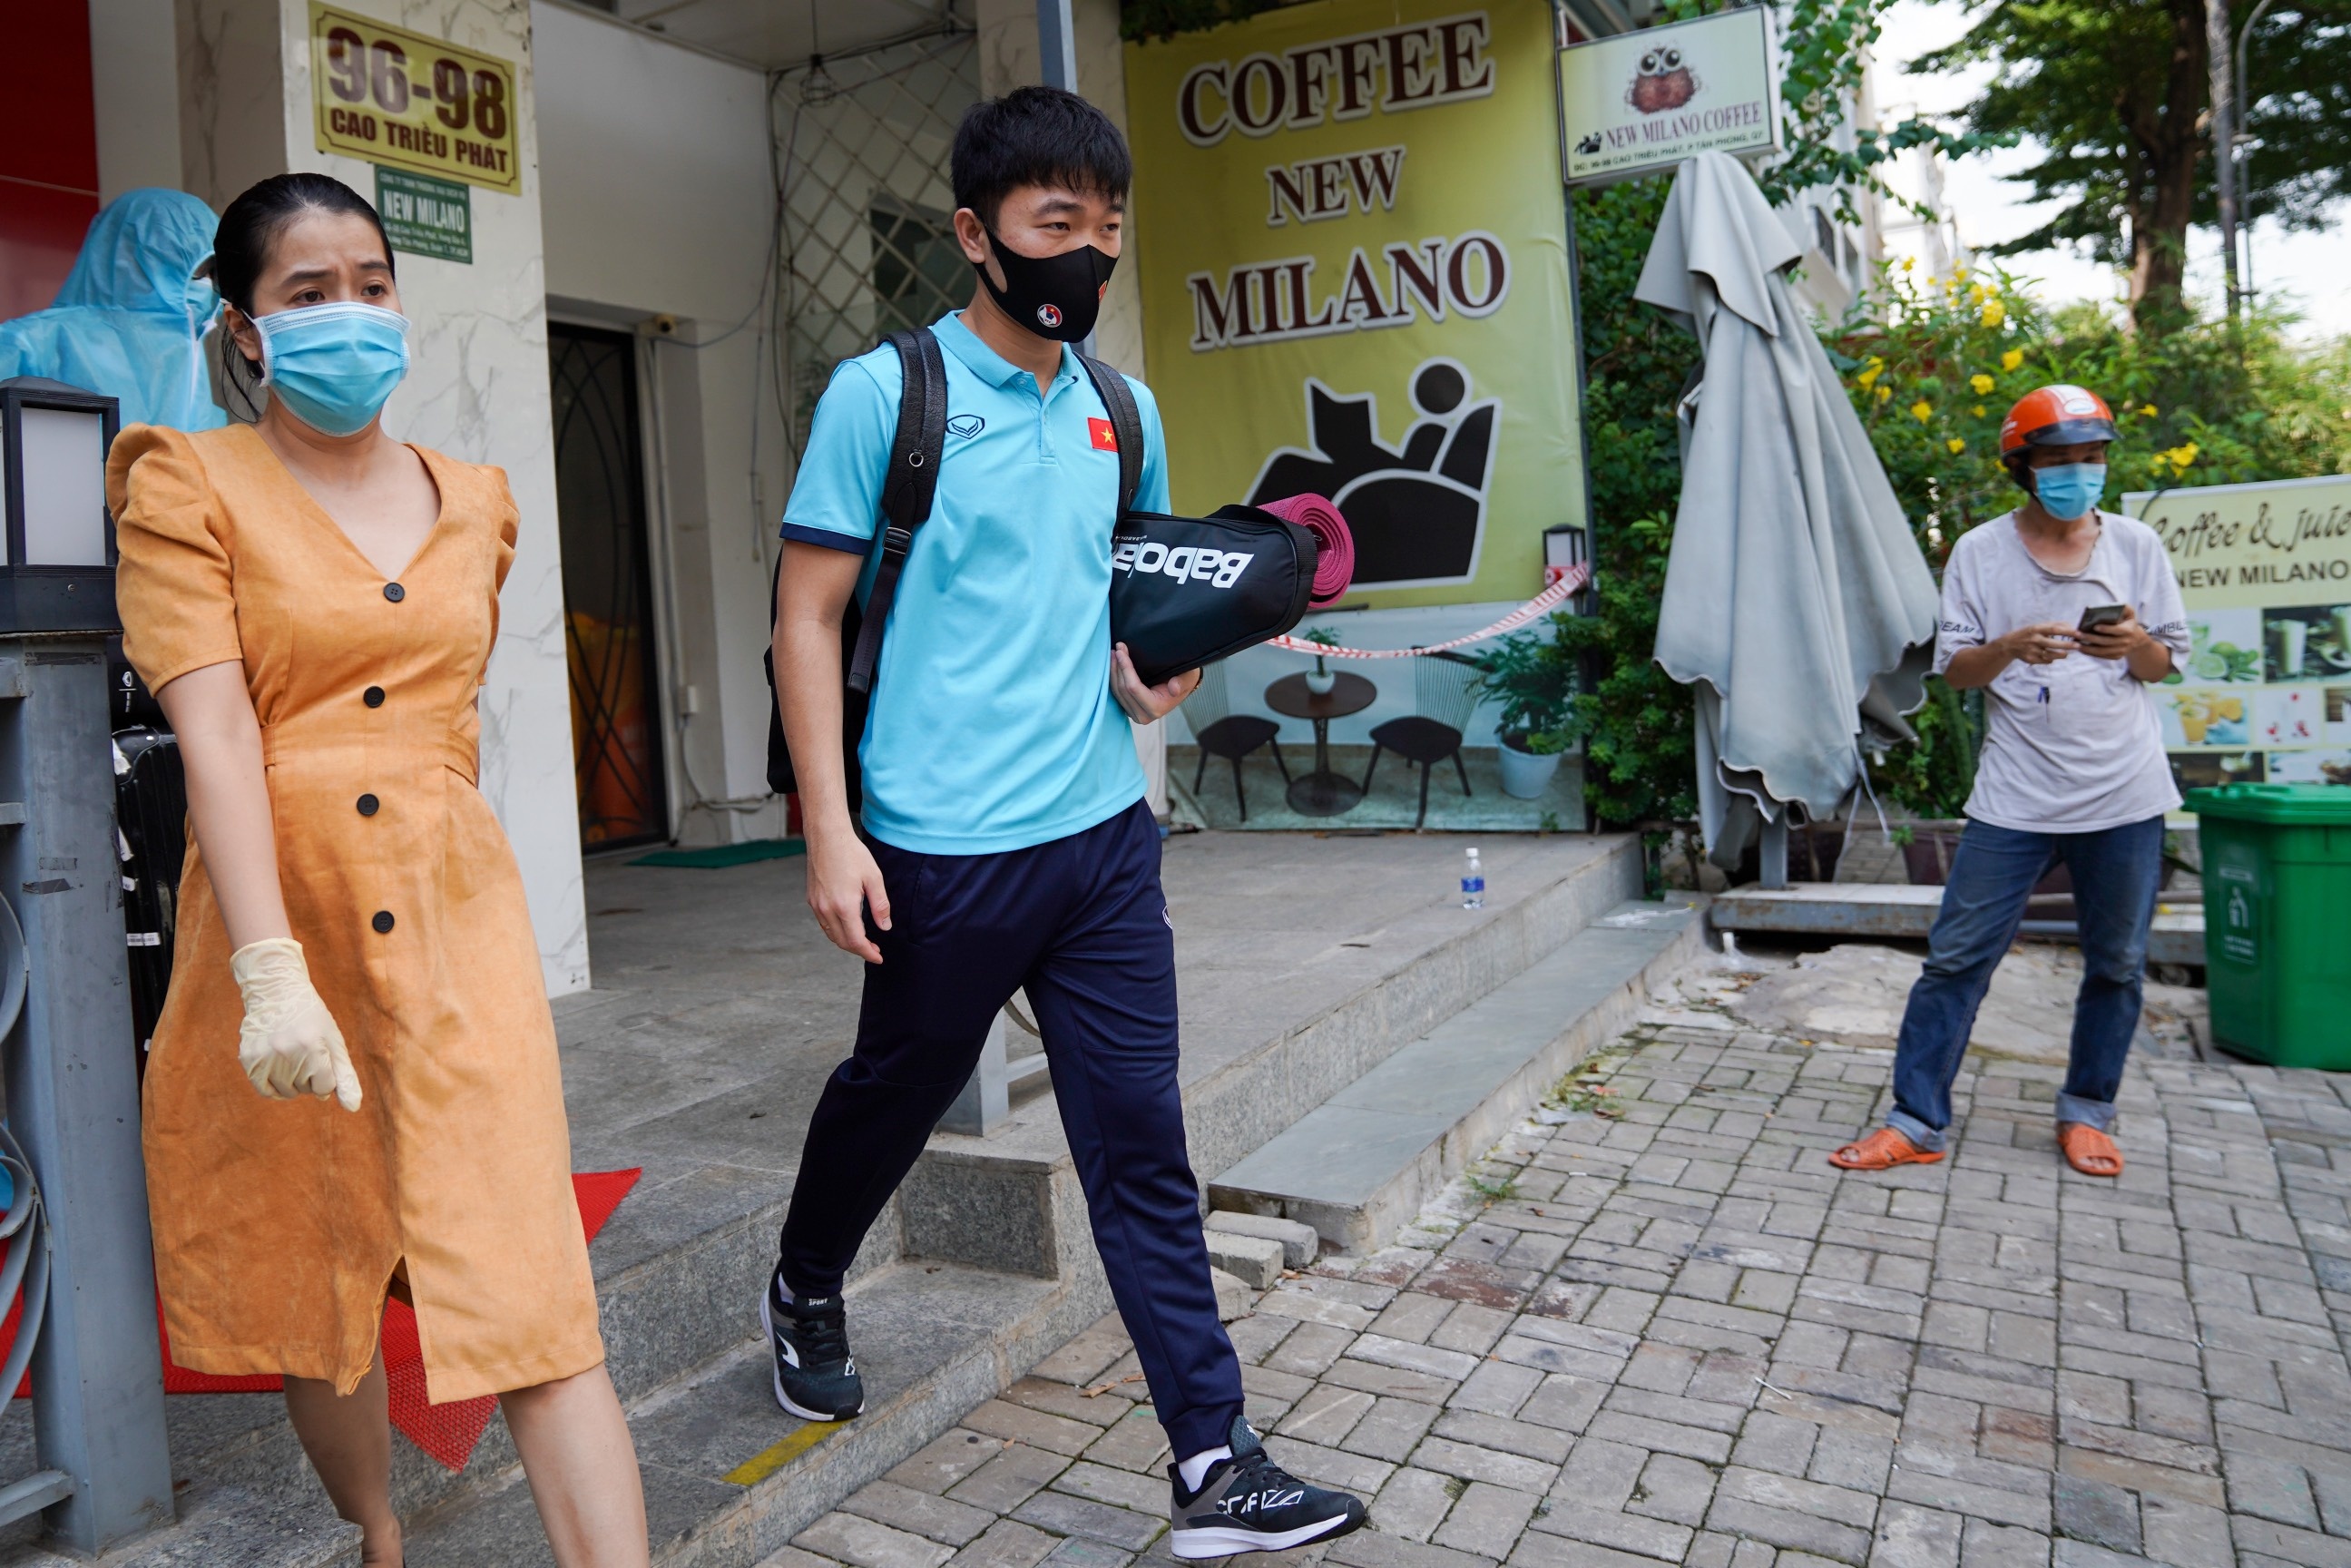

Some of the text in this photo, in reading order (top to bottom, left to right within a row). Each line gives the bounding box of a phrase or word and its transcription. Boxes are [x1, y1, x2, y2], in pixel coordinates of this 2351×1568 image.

[328, 26, 507, 140] 96-98
[1179, 14, 1494, 143] COFFEE
[330, 107, 508, 173] CAO TRIỀU PHÁT
[1607, 102, 1762, 151] NEW MILANO COFFEE
[384, 189, 414, 222] NEW
[416, 196, 465, 234] MILANO
[1266, 146, 1406, 223] NEW
[1187, 232, 1510, 349] MILANO
[2249, 501, 2282, 549] &
[2239, 559, 2350, 585] MILANO
